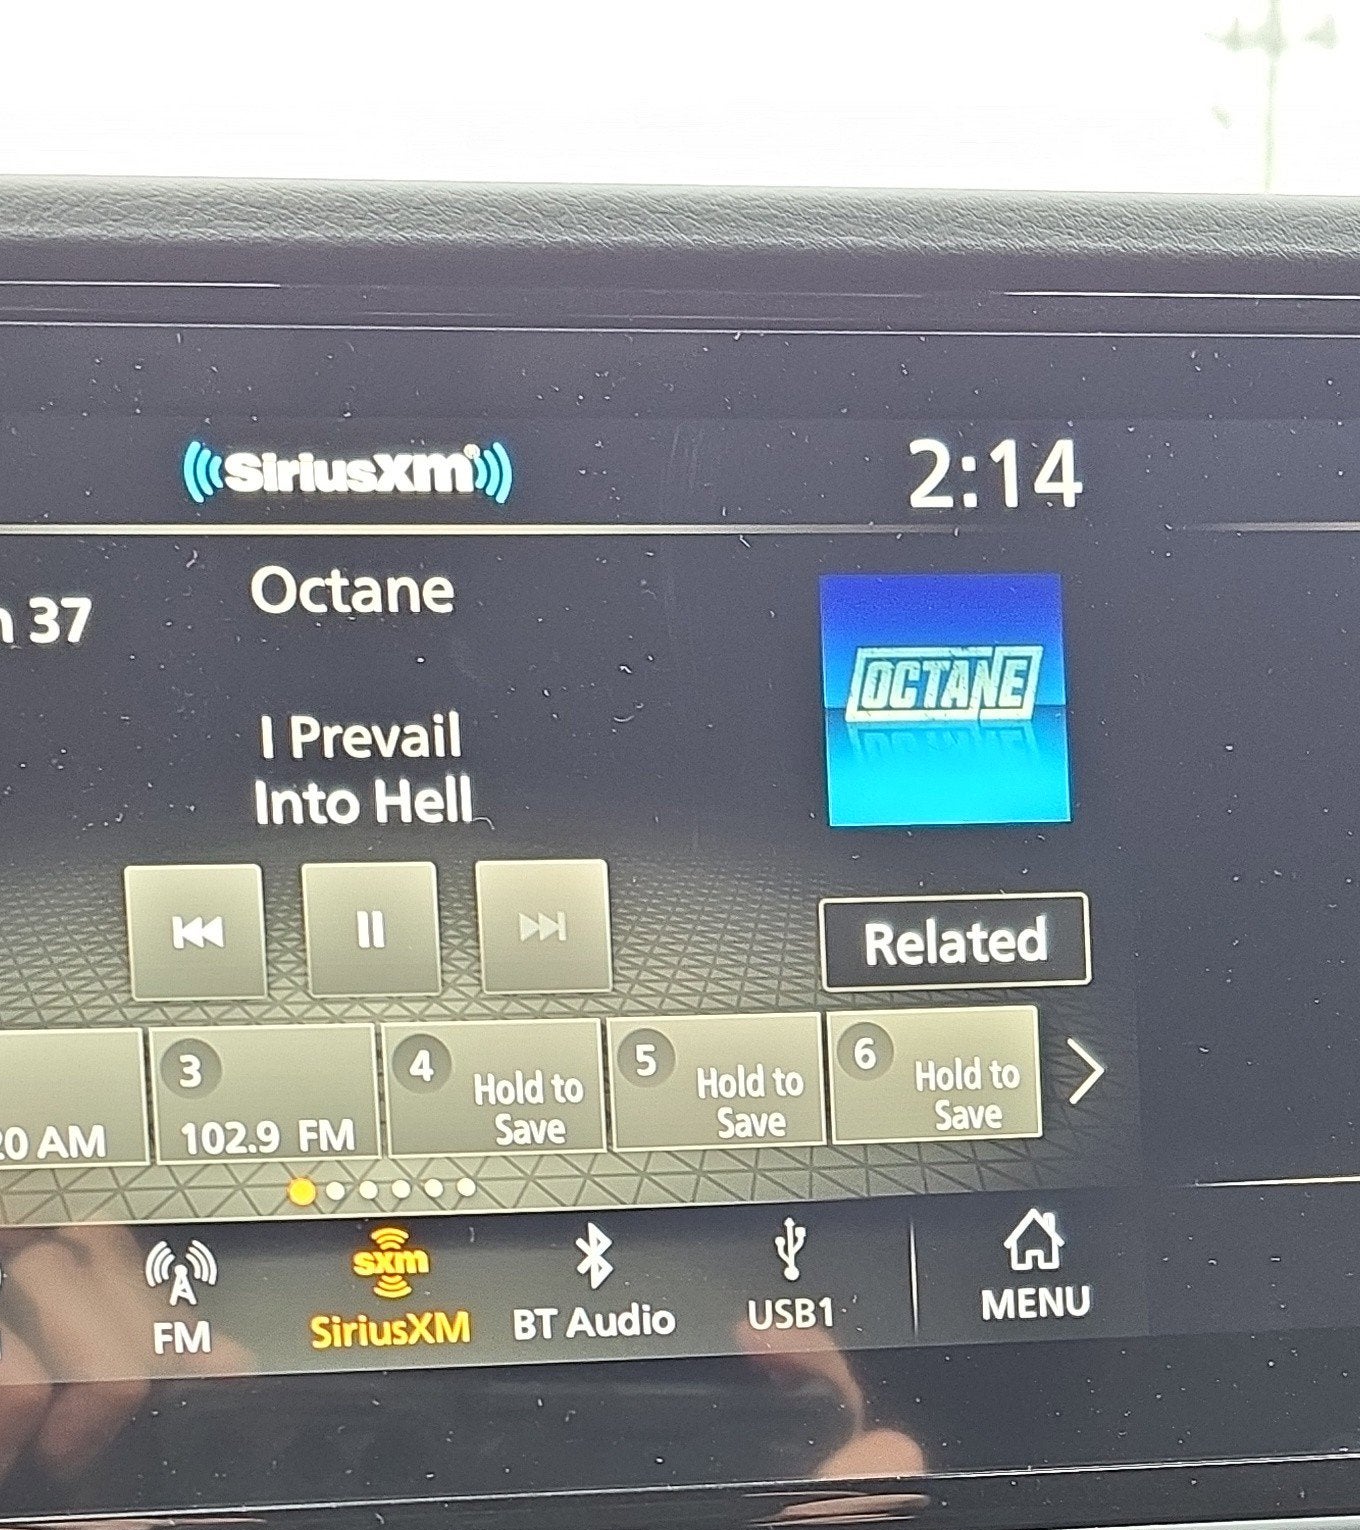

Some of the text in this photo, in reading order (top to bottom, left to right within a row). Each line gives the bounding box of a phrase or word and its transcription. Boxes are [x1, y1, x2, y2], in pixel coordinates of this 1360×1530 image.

[909, 439, 1083, 509] 2:14
[250, 564, 453, 616] Octane
[29, 596, 93, 644] 37
[855, 657, 1033, 710] OCTANE
[260, 711, 462, 759] I Prevail
[256, 776, 473, 826] Into Hell
[864, 919, 1048, 966] Related
[408, 1049, 433, 1083] 4
[635, 1044, 657, 1077] 5
[853, 1037, 876, 1070] 6
[180, 1055, 201, 1088] 3
[473, 1071, 584, 1106] Hold to
[696, 1067, 803, 1101] Hold to
[915, 1058, 1020, 1092] Hold to
[494, 1113, 566, 1147] Save
[717, 1106, 787, 1139] Save
[935, 1098, 1002, 1131] Save
[38, 1125, 106, 1160] AM
[181, 1118, 355, 1156] 102.9 FM
[749, 1297, 834, 1331] USB1
[981, 1285, 1091, 1322] MENU
[154, 1321, 211, 1355] FM
[311, 1312, 471, 1351] SiriusXM
[513, 1303, 676, 1342] BT Audio
